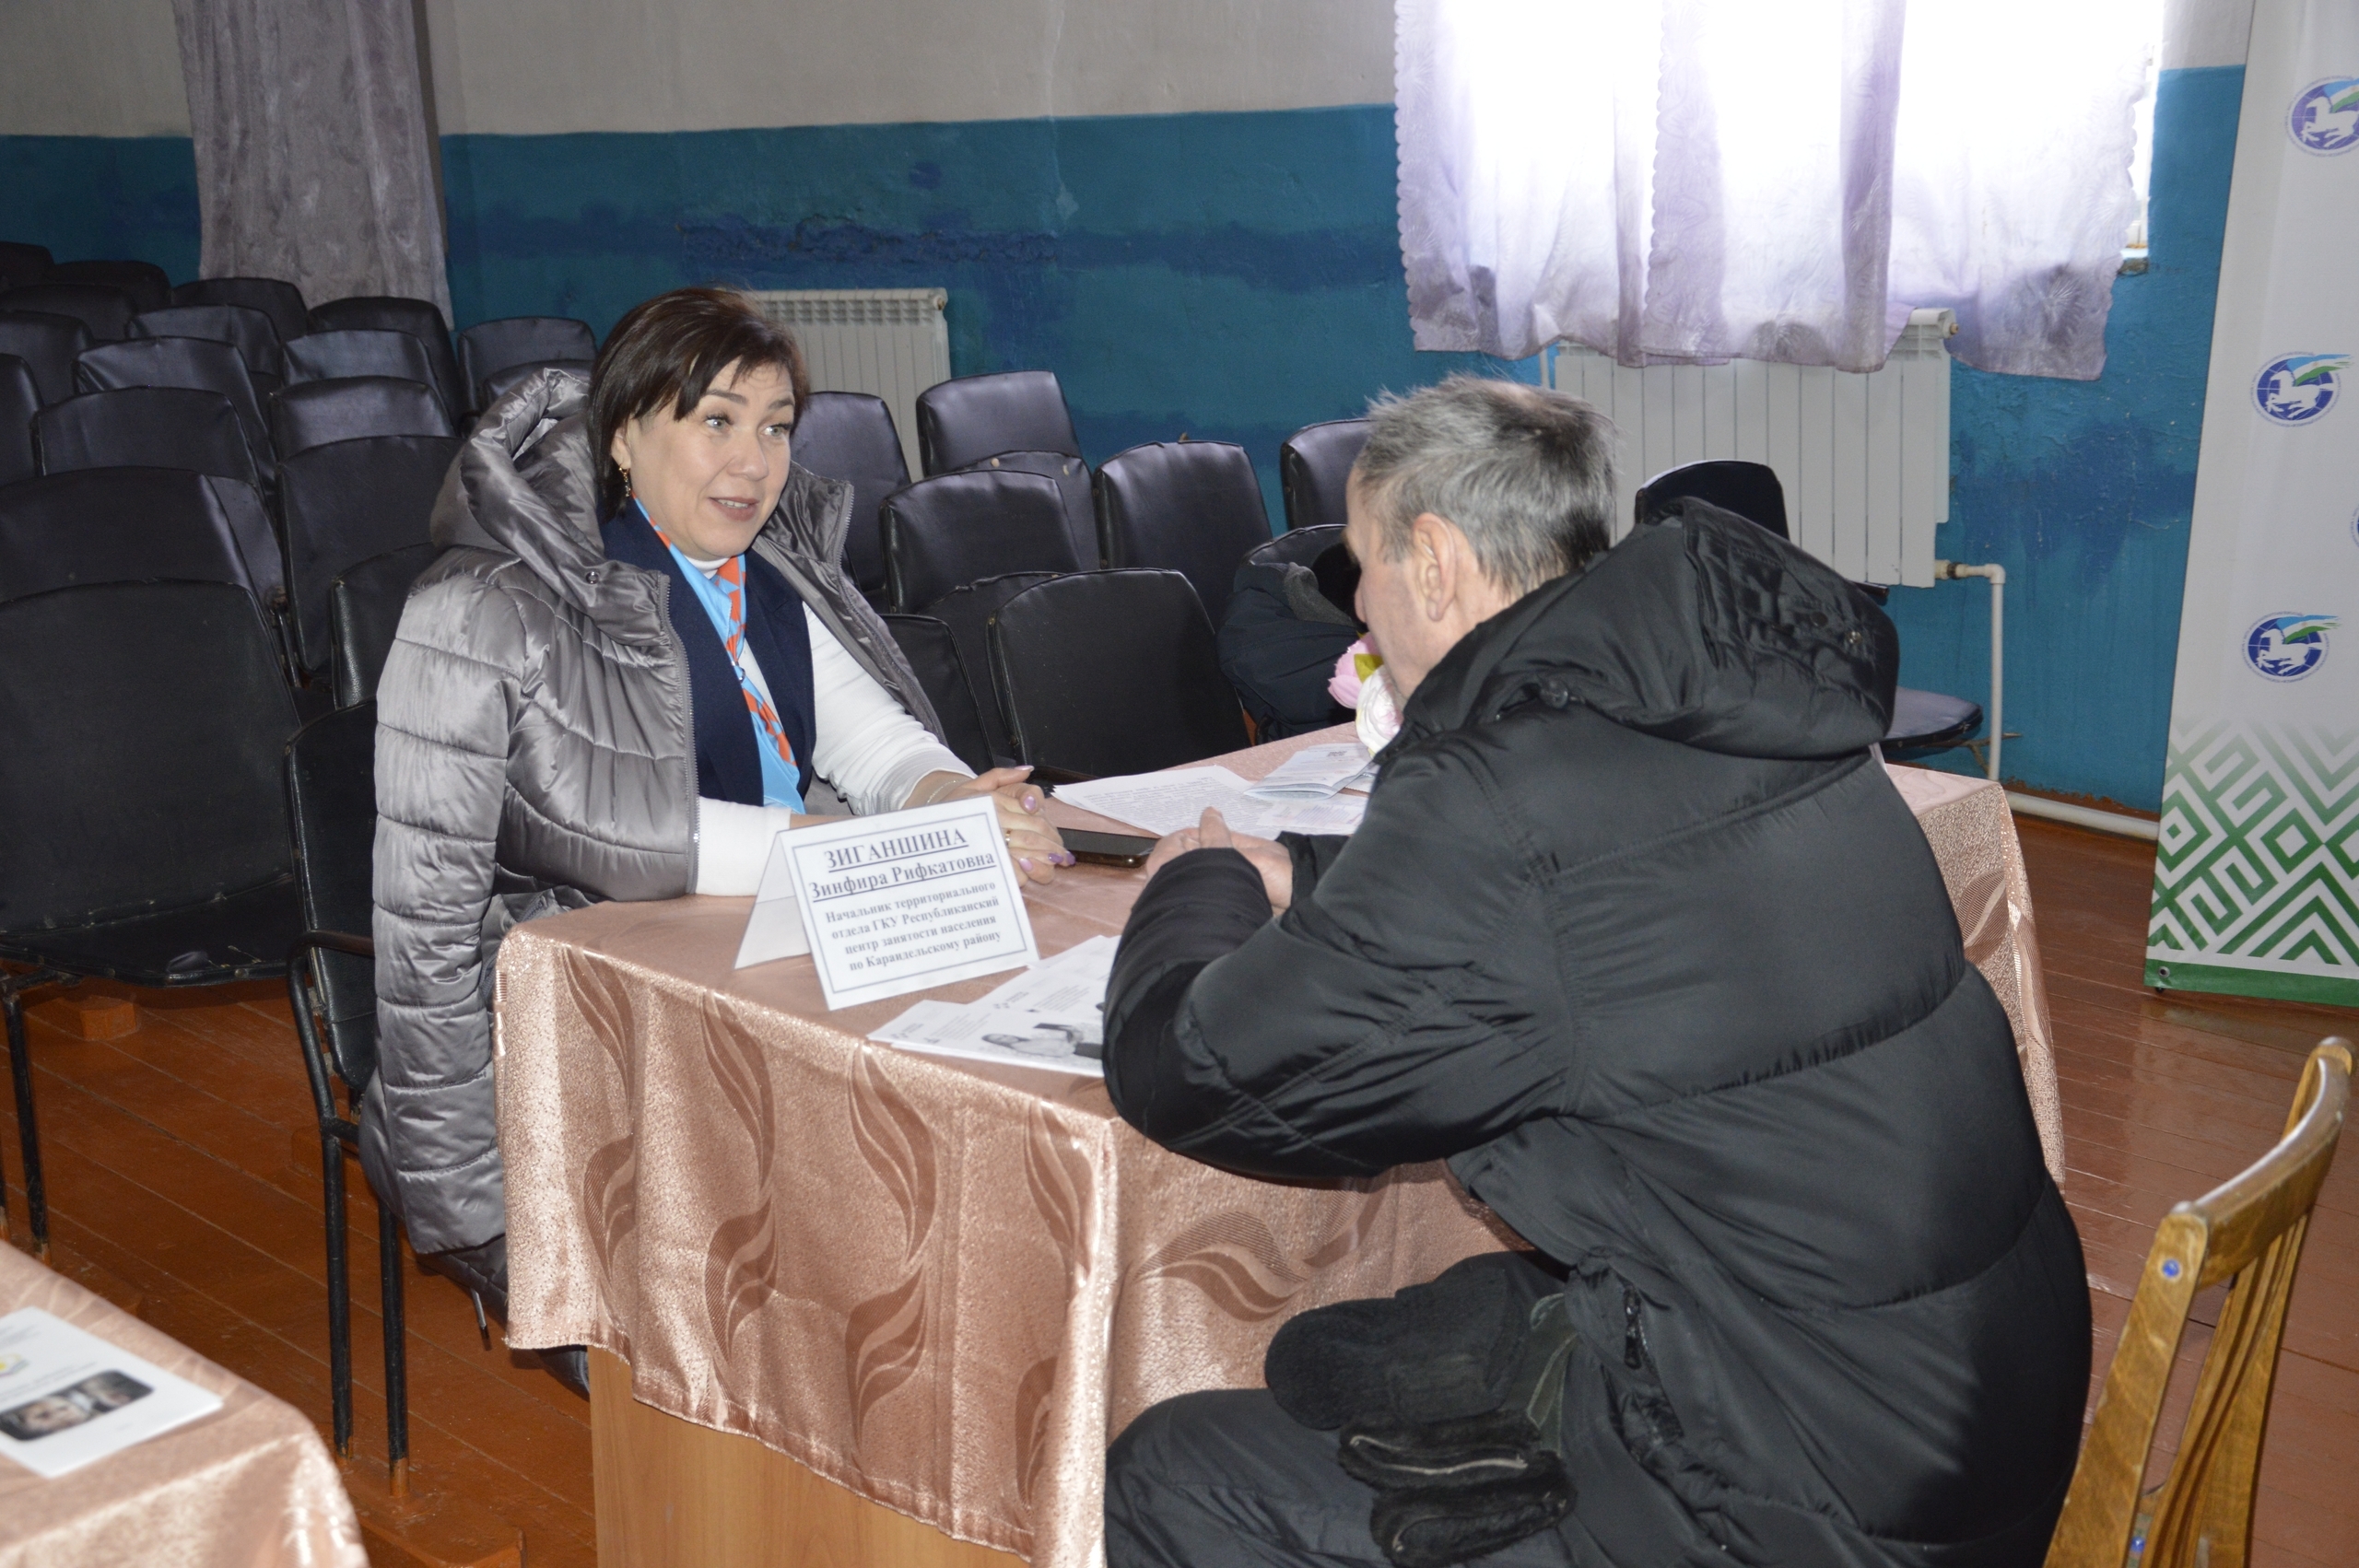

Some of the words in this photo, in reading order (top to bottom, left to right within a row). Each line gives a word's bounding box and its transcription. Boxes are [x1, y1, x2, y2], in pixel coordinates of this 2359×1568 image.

[824, 828, 967, 869] ЗИГАНШИНА
[809, 873, 889, 899] Зинфира
[891, 853, 996, 883] Рифкатовна
[825, 903, 892, 923] Начальник
[894, 882, 996, 910] территориального
[831, 924, 871, 940] отдела
[872, 916, 898, 931] ГКУ
[901, 895, 1000, 925] Республиканский
[844, 940, 879, 955] центр
[882, 928, 938, 947] занятости
[940, 915, 997, 934] населения
[849, 961, 864, 972] по
[962, 931, 1001, 950] району
